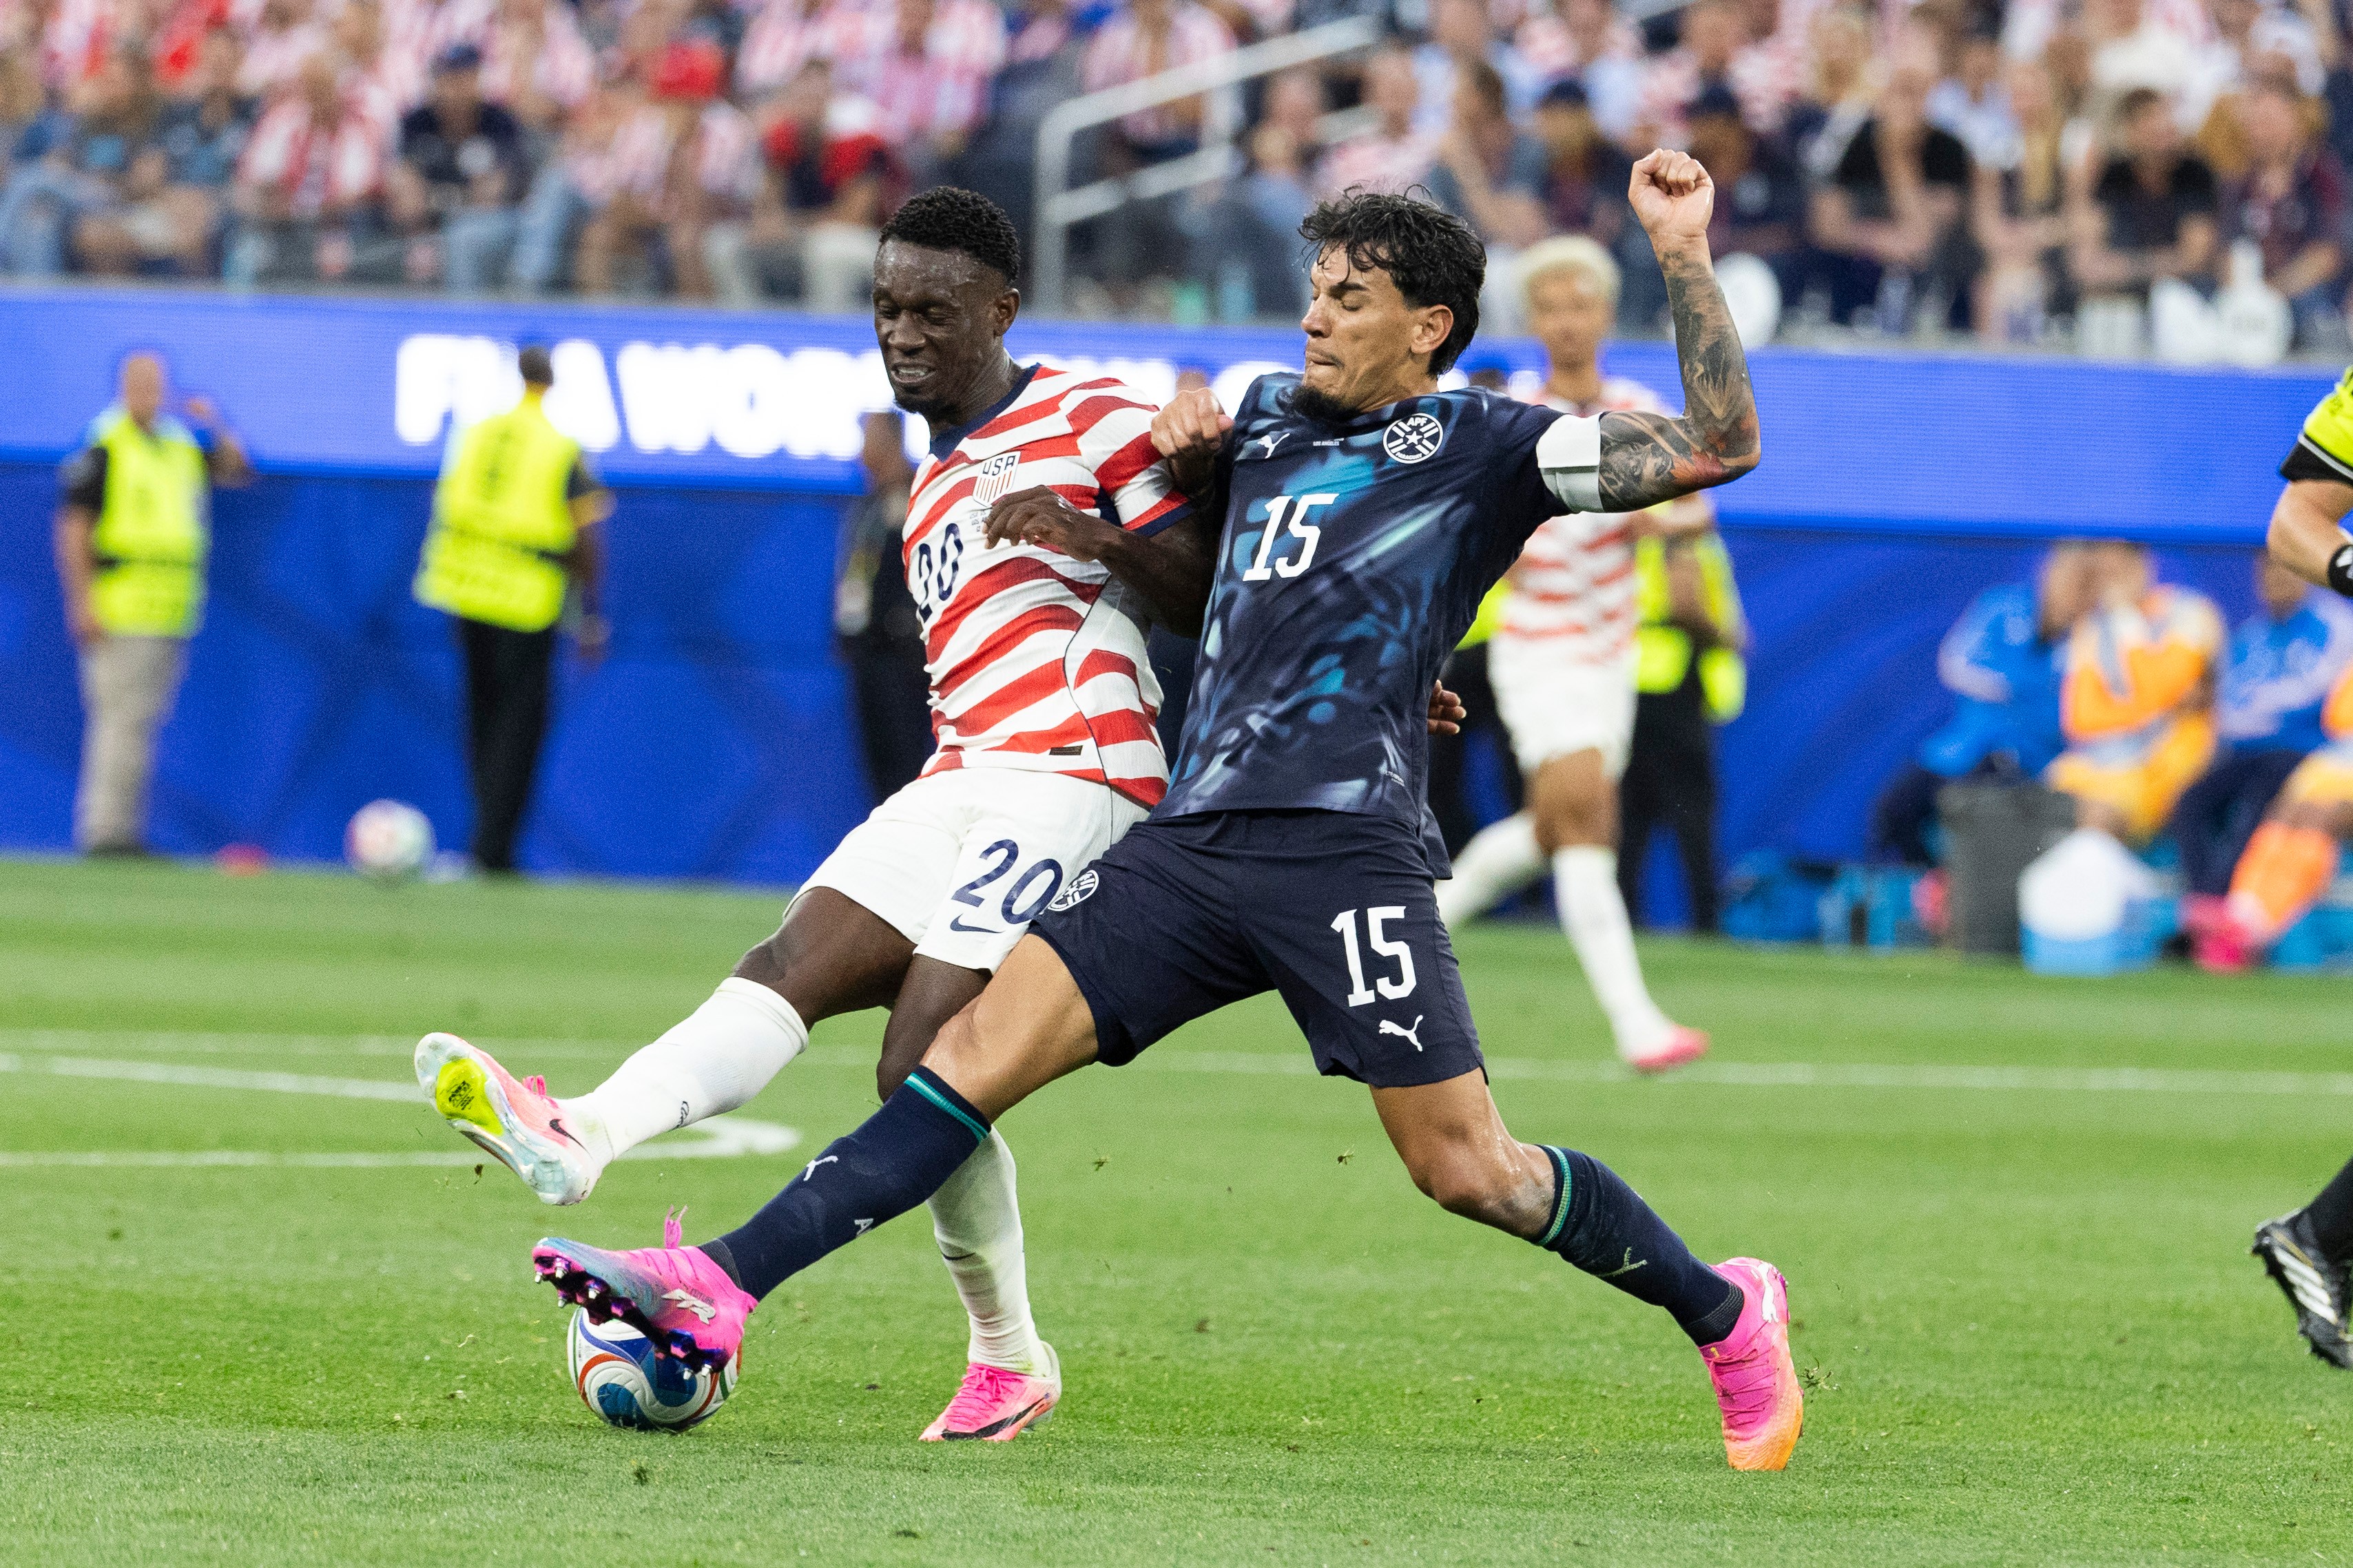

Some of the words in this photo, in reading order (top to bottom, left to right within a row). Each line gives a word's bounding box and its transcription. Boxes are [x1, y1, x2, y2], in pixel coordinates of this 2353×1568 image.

[982, 454, 1016, 476] USA
[1407, 417, 1428, 426] APF
[918, 523, 964, 624] 20
[1243, 493, 1339, 582] 15
[951, 839, 1064, 925] 20
[1330, 906, 1418, 1007] 15
